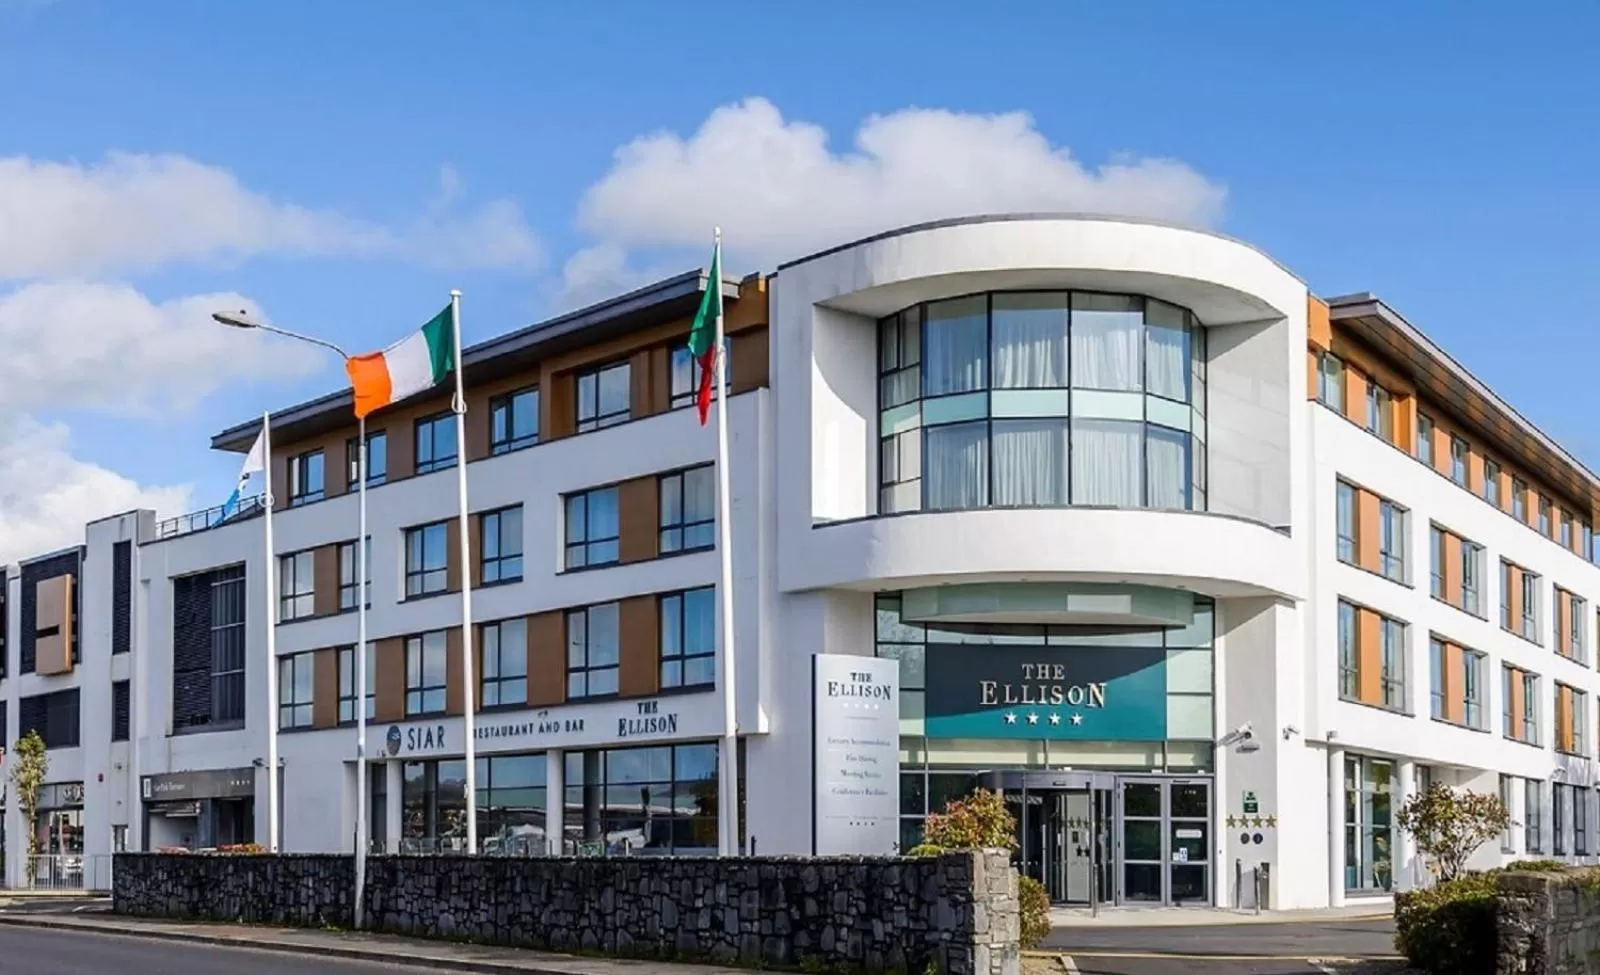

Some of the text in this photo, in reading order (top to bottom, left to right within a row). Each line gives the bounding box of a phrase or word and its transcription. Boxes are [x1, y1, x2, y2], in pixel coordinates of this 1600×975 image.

[849, 672, 872, 682] THE
[1022, 663, 1065, 680] THE
[828, 681, 891, 700] ELLISON
[979, 681, 1107, 708] ELLISON
[637, 700, 658, 714] THE
[472, 719, 584, 739] RESTAURANT AND BAR
[618, 713, 678, 737] ELLISON
[407, 725, 445, 751] SIAR
